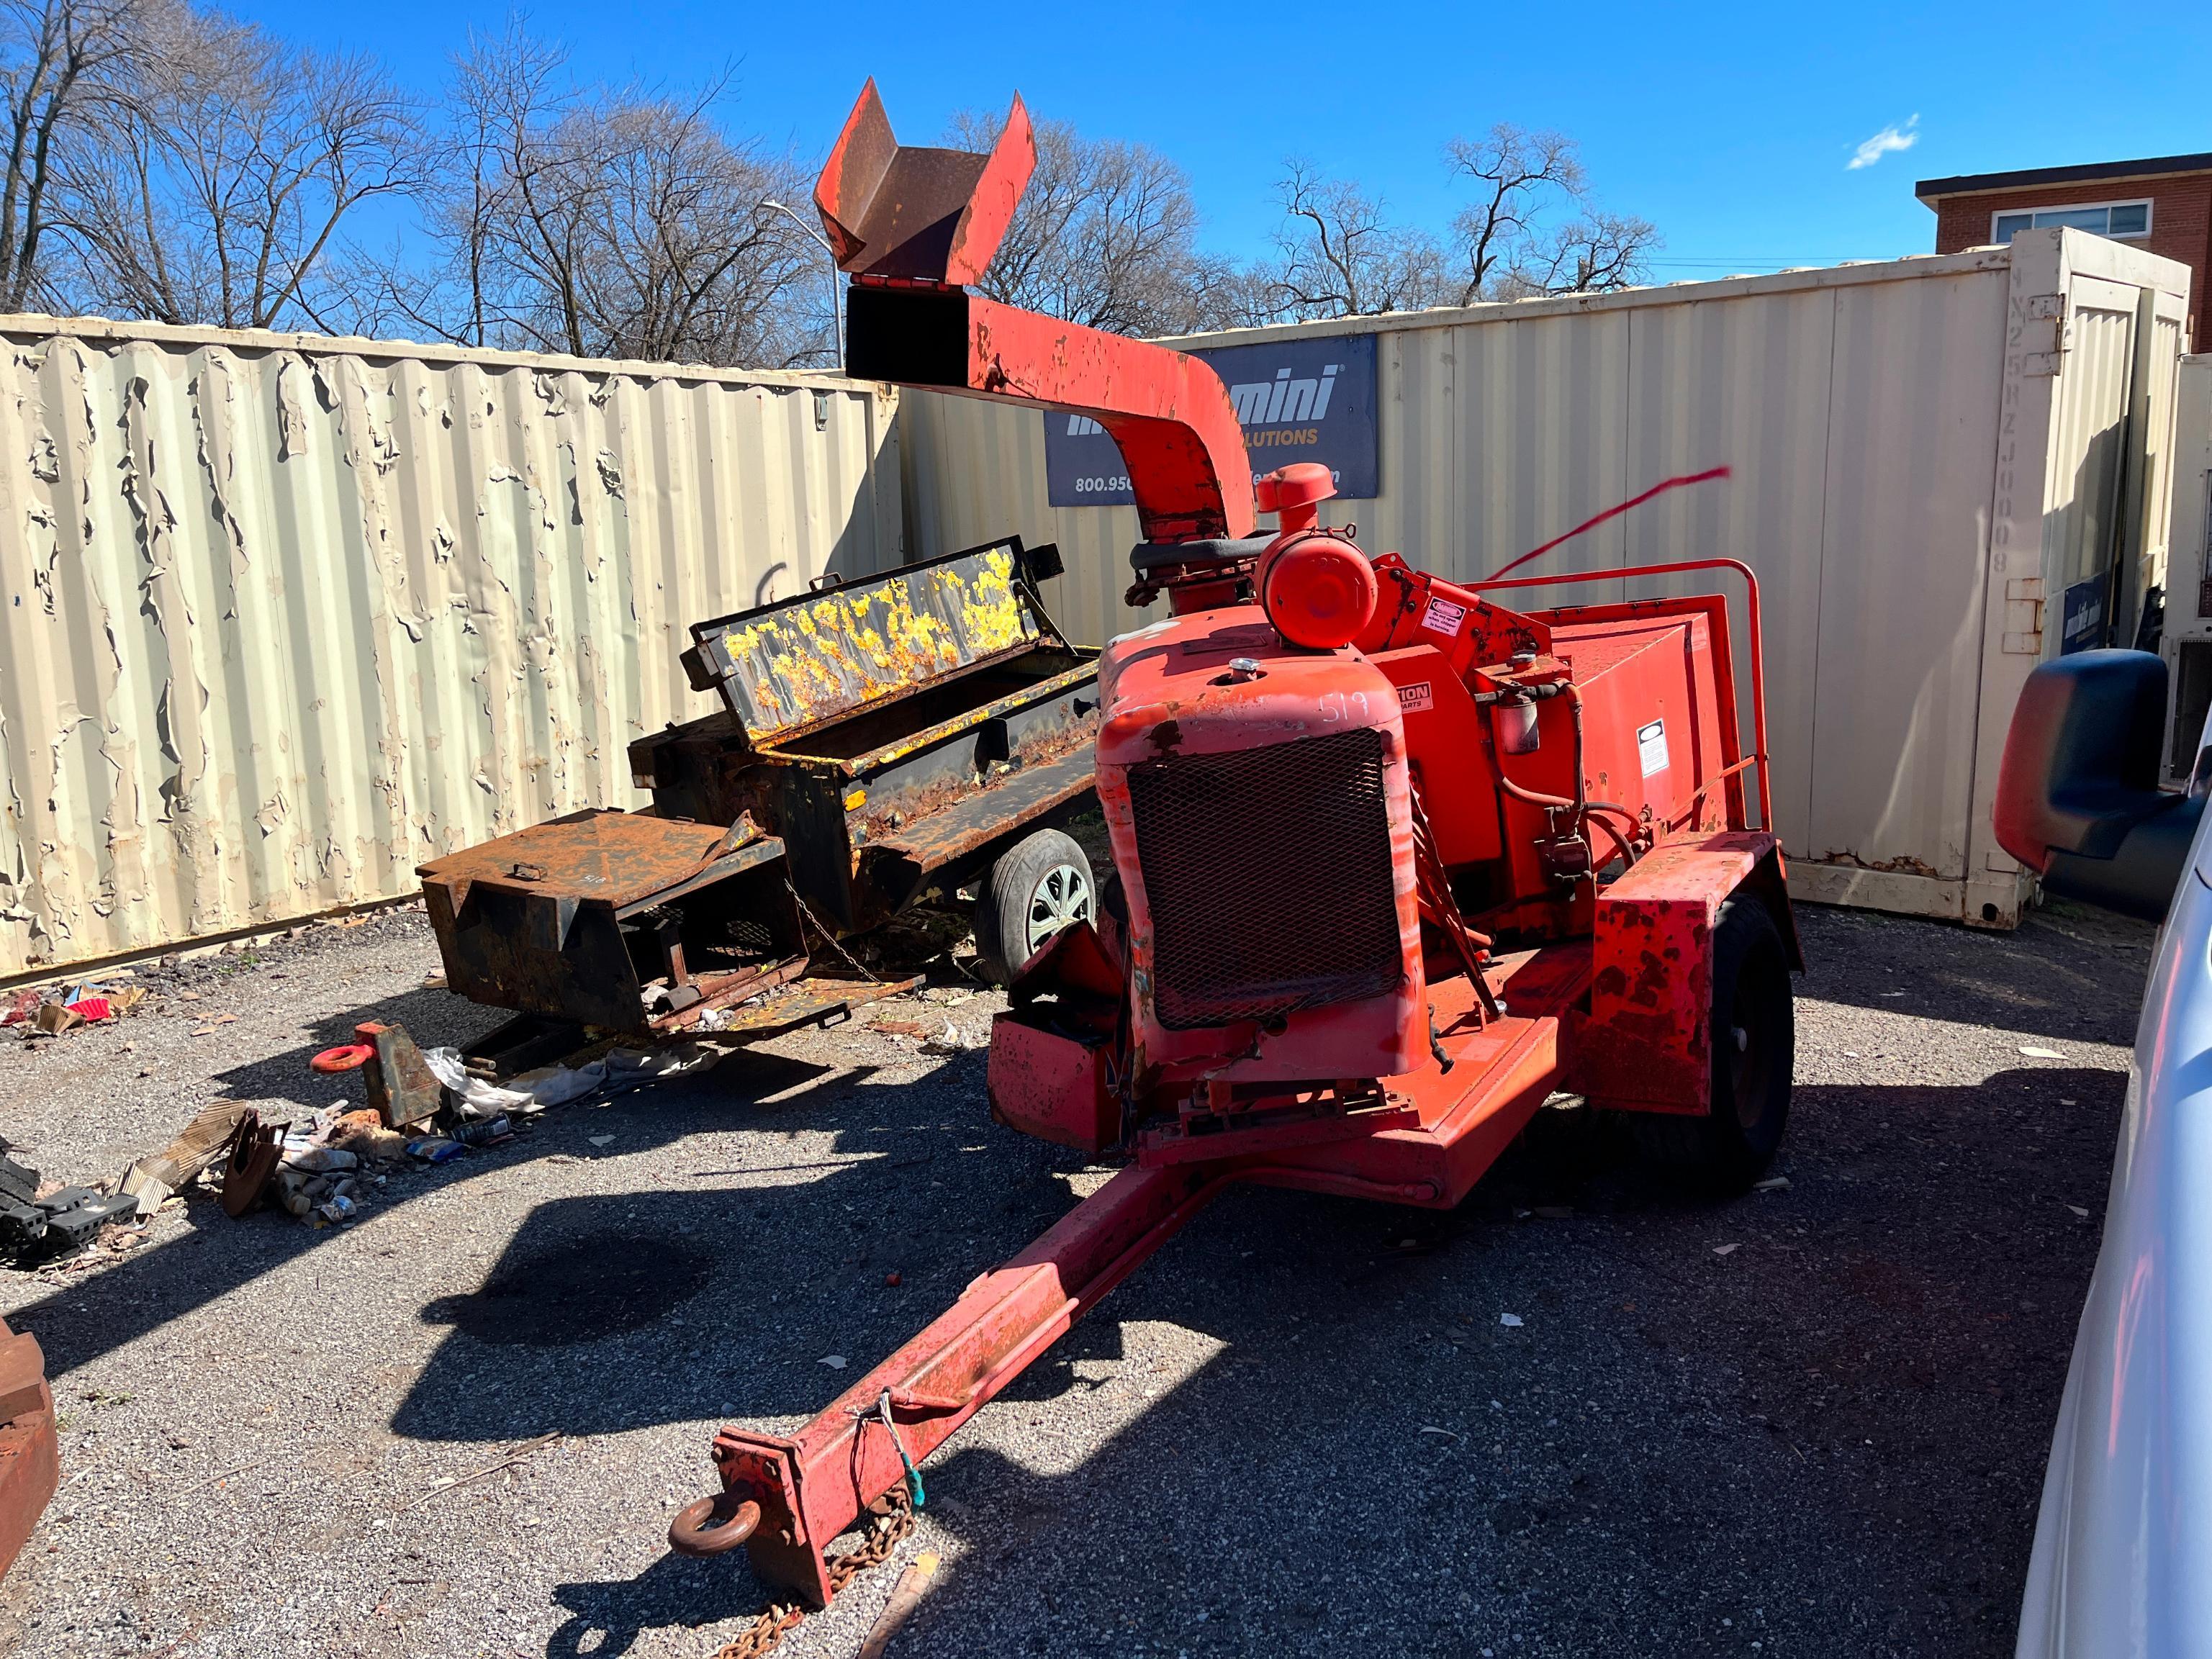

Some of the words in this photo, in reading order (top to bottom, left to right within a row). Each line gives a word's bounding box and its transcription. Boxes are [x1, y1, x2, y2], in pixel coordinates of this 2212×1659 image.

[1245, 428, 1318, 448] LUTIONS
[1398, 686, 1428, 701] ION
[1319, 692, 1368, 722] 519
